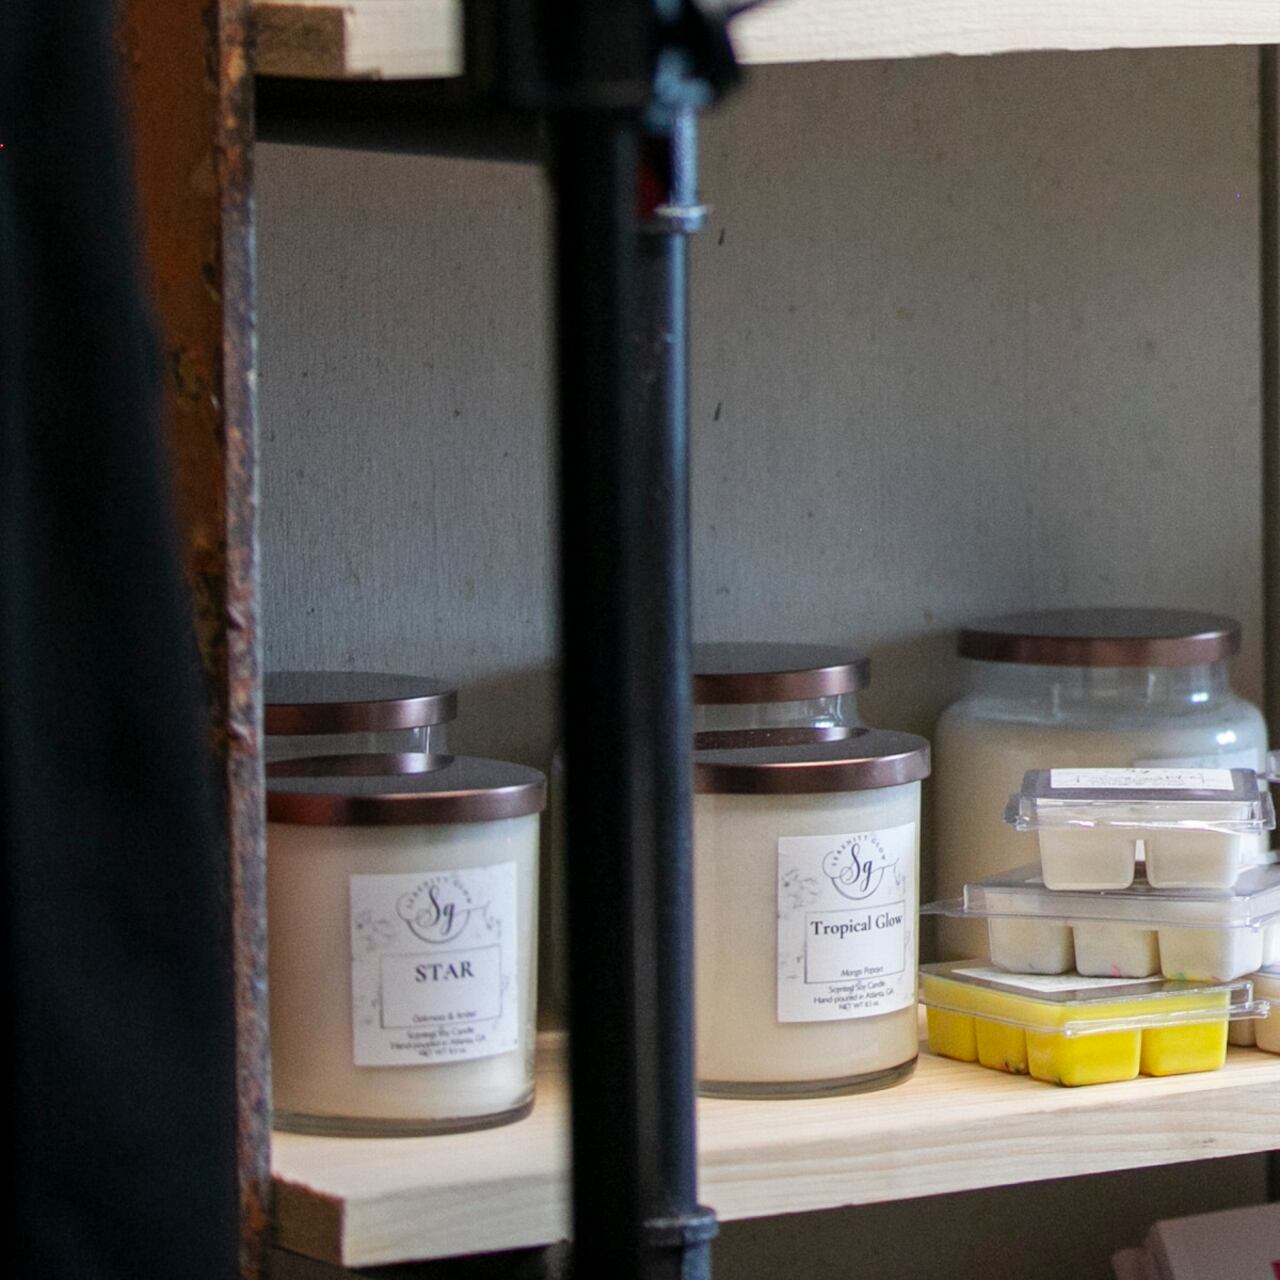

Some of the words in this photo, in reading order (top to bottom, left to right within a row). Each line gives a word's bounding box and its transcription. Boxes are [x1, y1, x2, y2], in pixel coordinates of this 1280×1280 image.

[810, 914, 872, 940] Tropical
[874, 912, 903, 931] Glow
[415, 960, 475, 984] STAR
